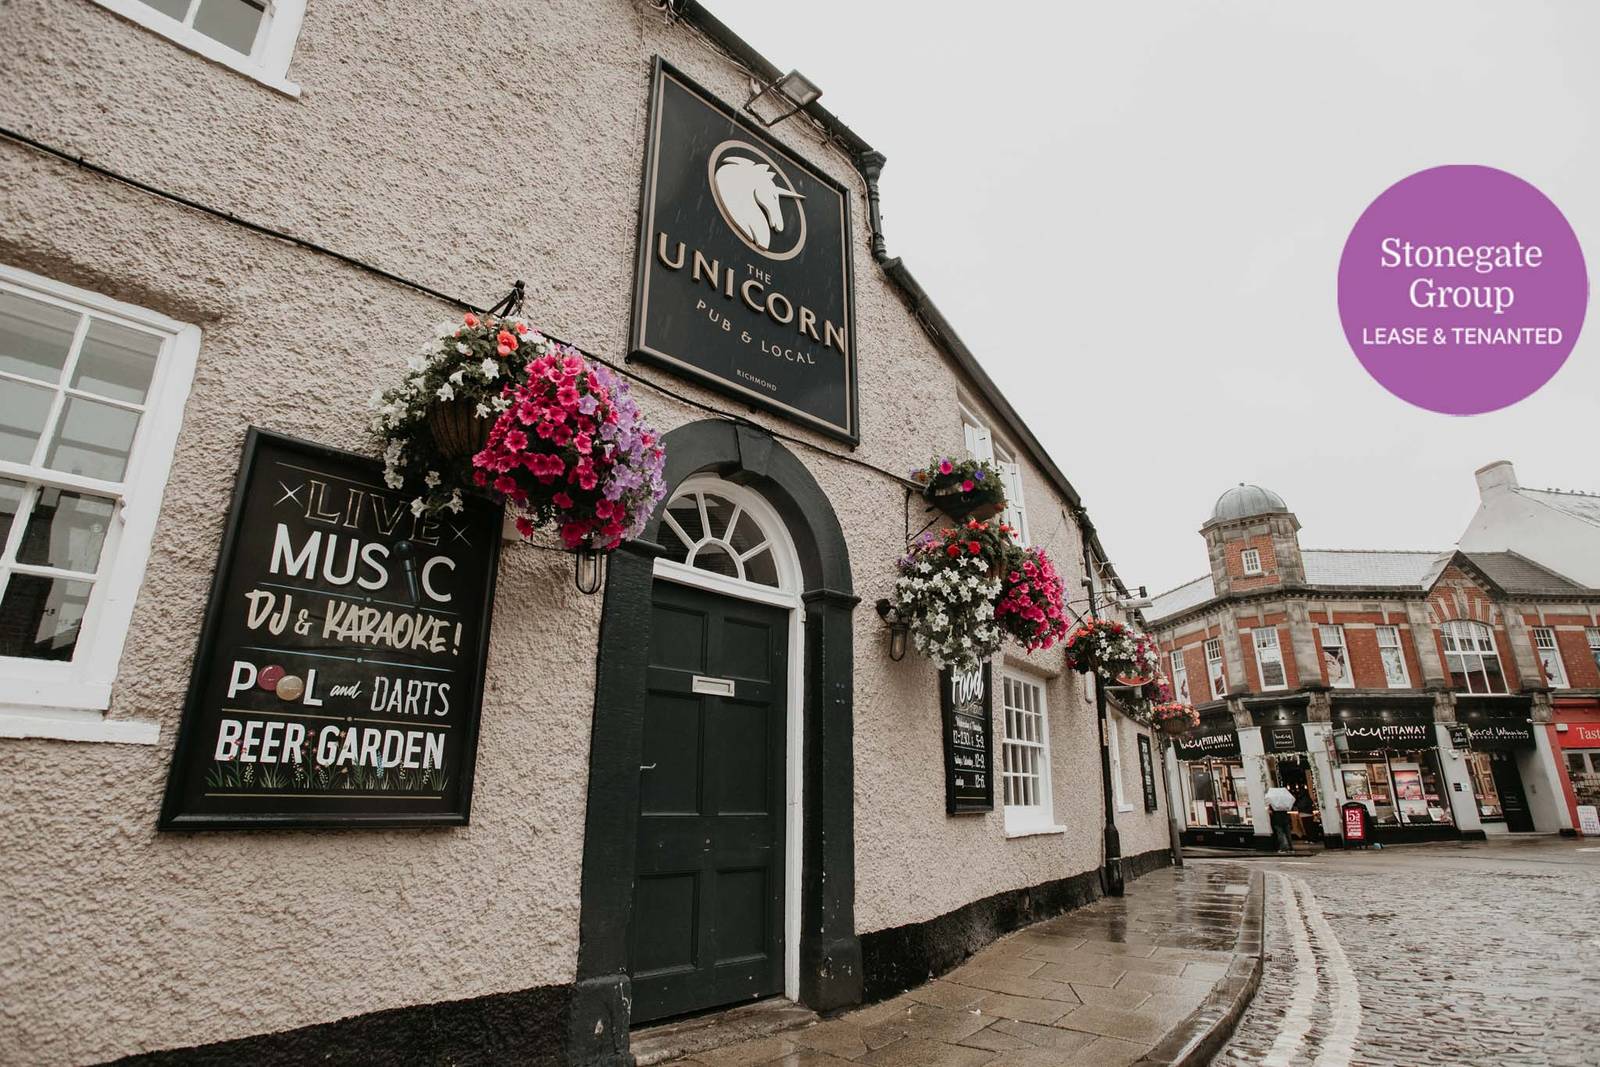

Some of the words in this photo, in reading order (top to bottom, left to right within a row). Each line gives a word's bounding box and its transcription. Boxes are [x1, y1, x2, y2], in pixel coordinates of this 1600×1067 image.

[656, 231, 845, 353] UNICORN
[746, 263, 772, 286] THE
[696, 299, 732, 333] PUB
[741, 330, 752, 343] &
[761, 340, 816, 365] LOCAL
[736, 368, 777, 392] RICHMOND
[304, 480, 442, 547] LIVE
[244, 588, 293, 636] DJ
[295, 609, 314, 636] &
[322, 600, 463, 656] KARAOKE!
[330, 680, 364, 700] and
[370, 676, 451, 717] DARTS
[214, 719, 306, 764] BEER
[316, 727, 446, 769] GARDEN
[1201, 733, 1233, 745] PITTAWAY
[1382, 725, 1426, 735] PITTAWAY
